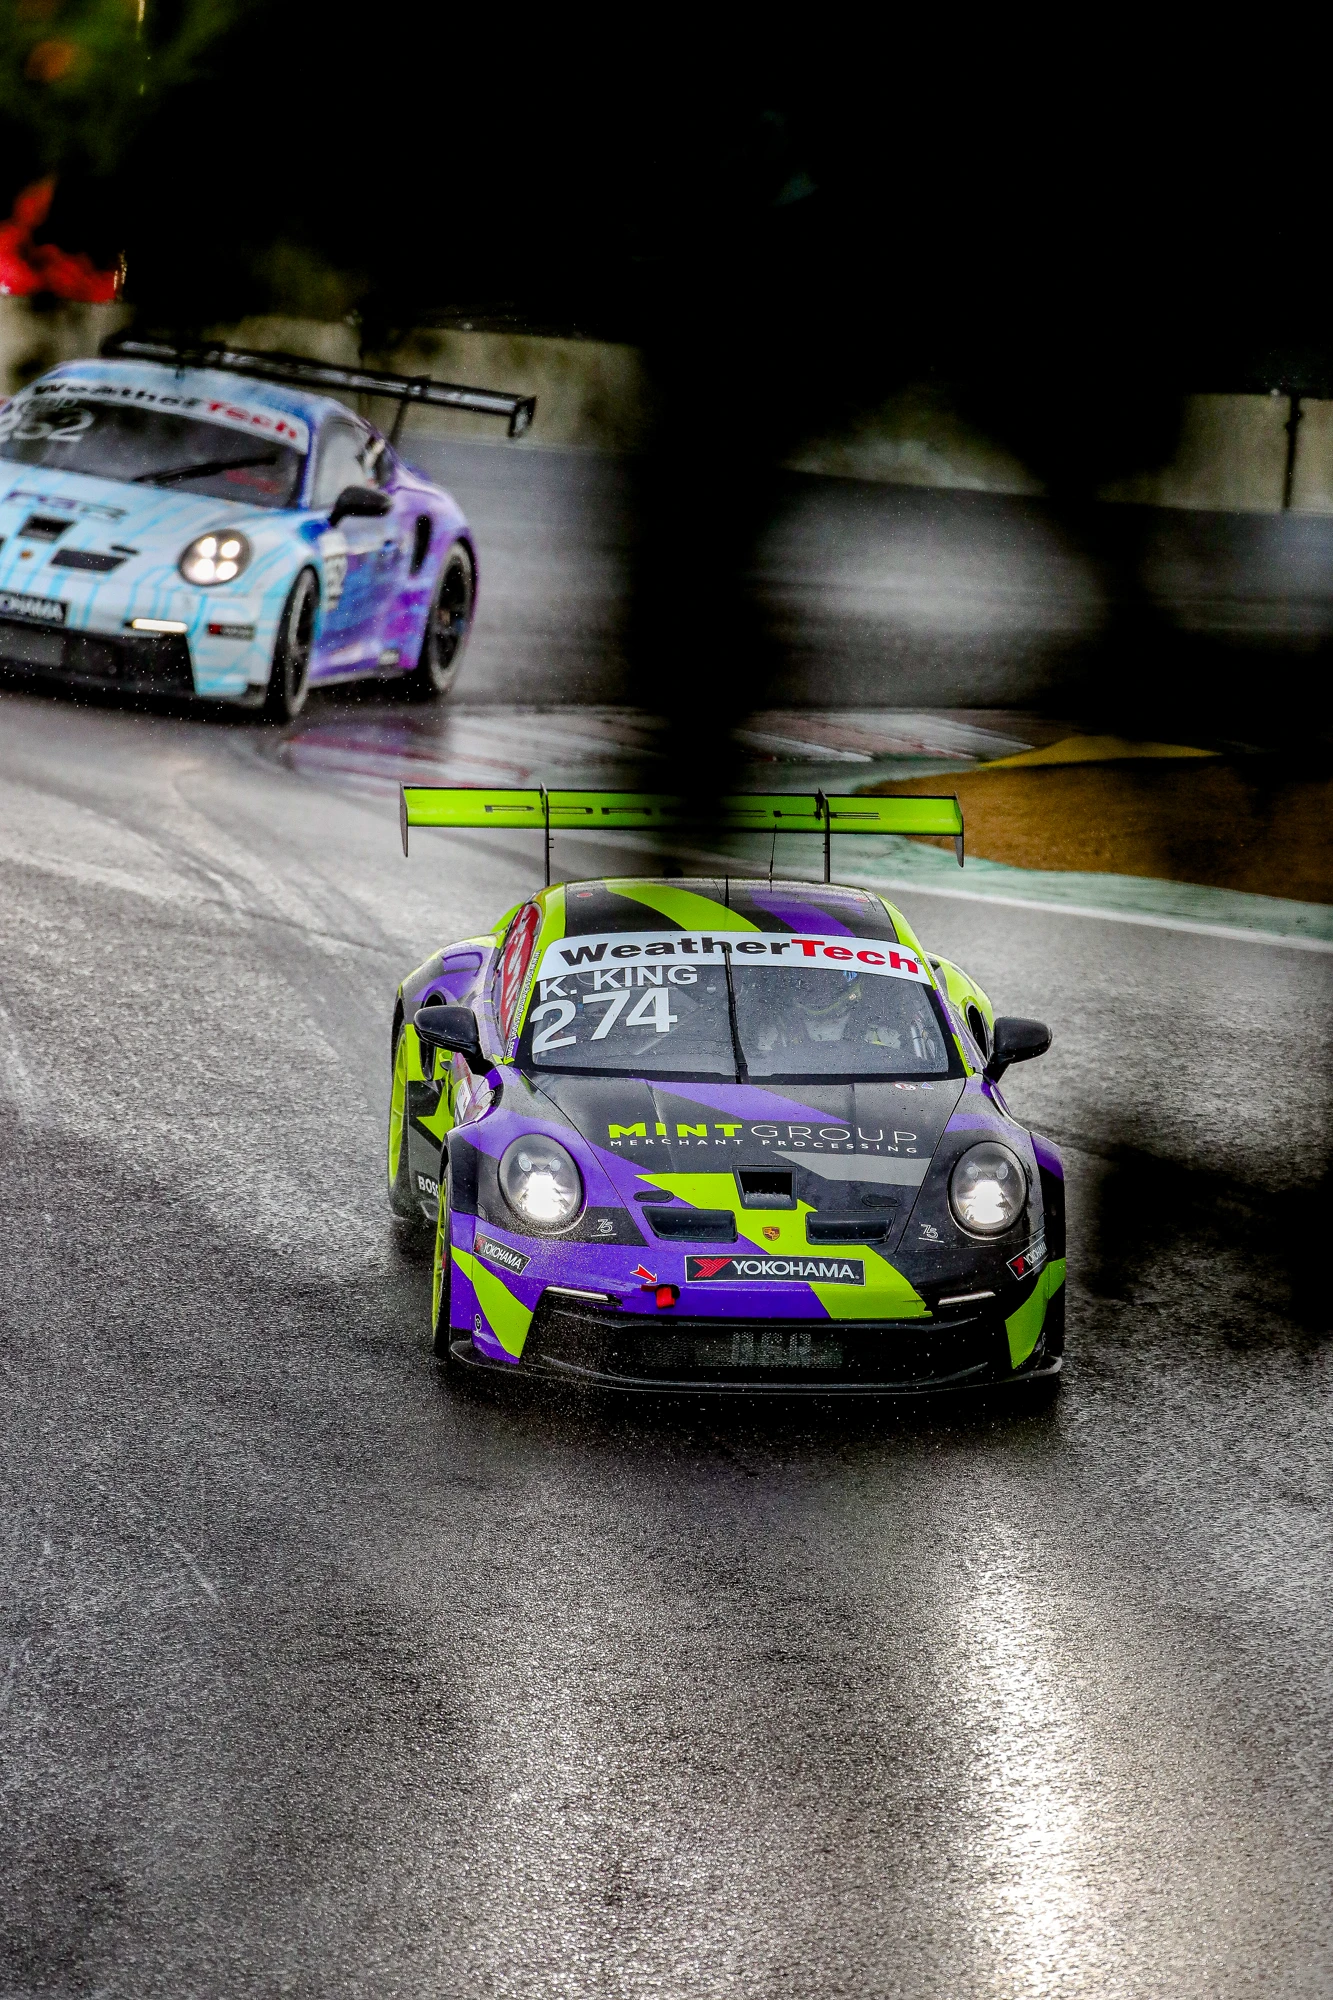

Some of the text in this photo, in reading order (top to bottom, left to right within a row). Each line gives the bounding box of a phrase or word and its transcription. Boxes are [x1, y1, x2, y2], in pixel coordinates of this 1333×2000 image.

[560, 937, 919, 974] WeatherTech
[540, 965, 698, 1001] K. KING
[530, 987, 678, 1053] 274
[610, 1138, 918, 1154] MERCHANT PROCESSING
[482, 1241, 522, 1270] YOKOHAMA
[732, 1259, 855, 1279] YOKOHAMA
